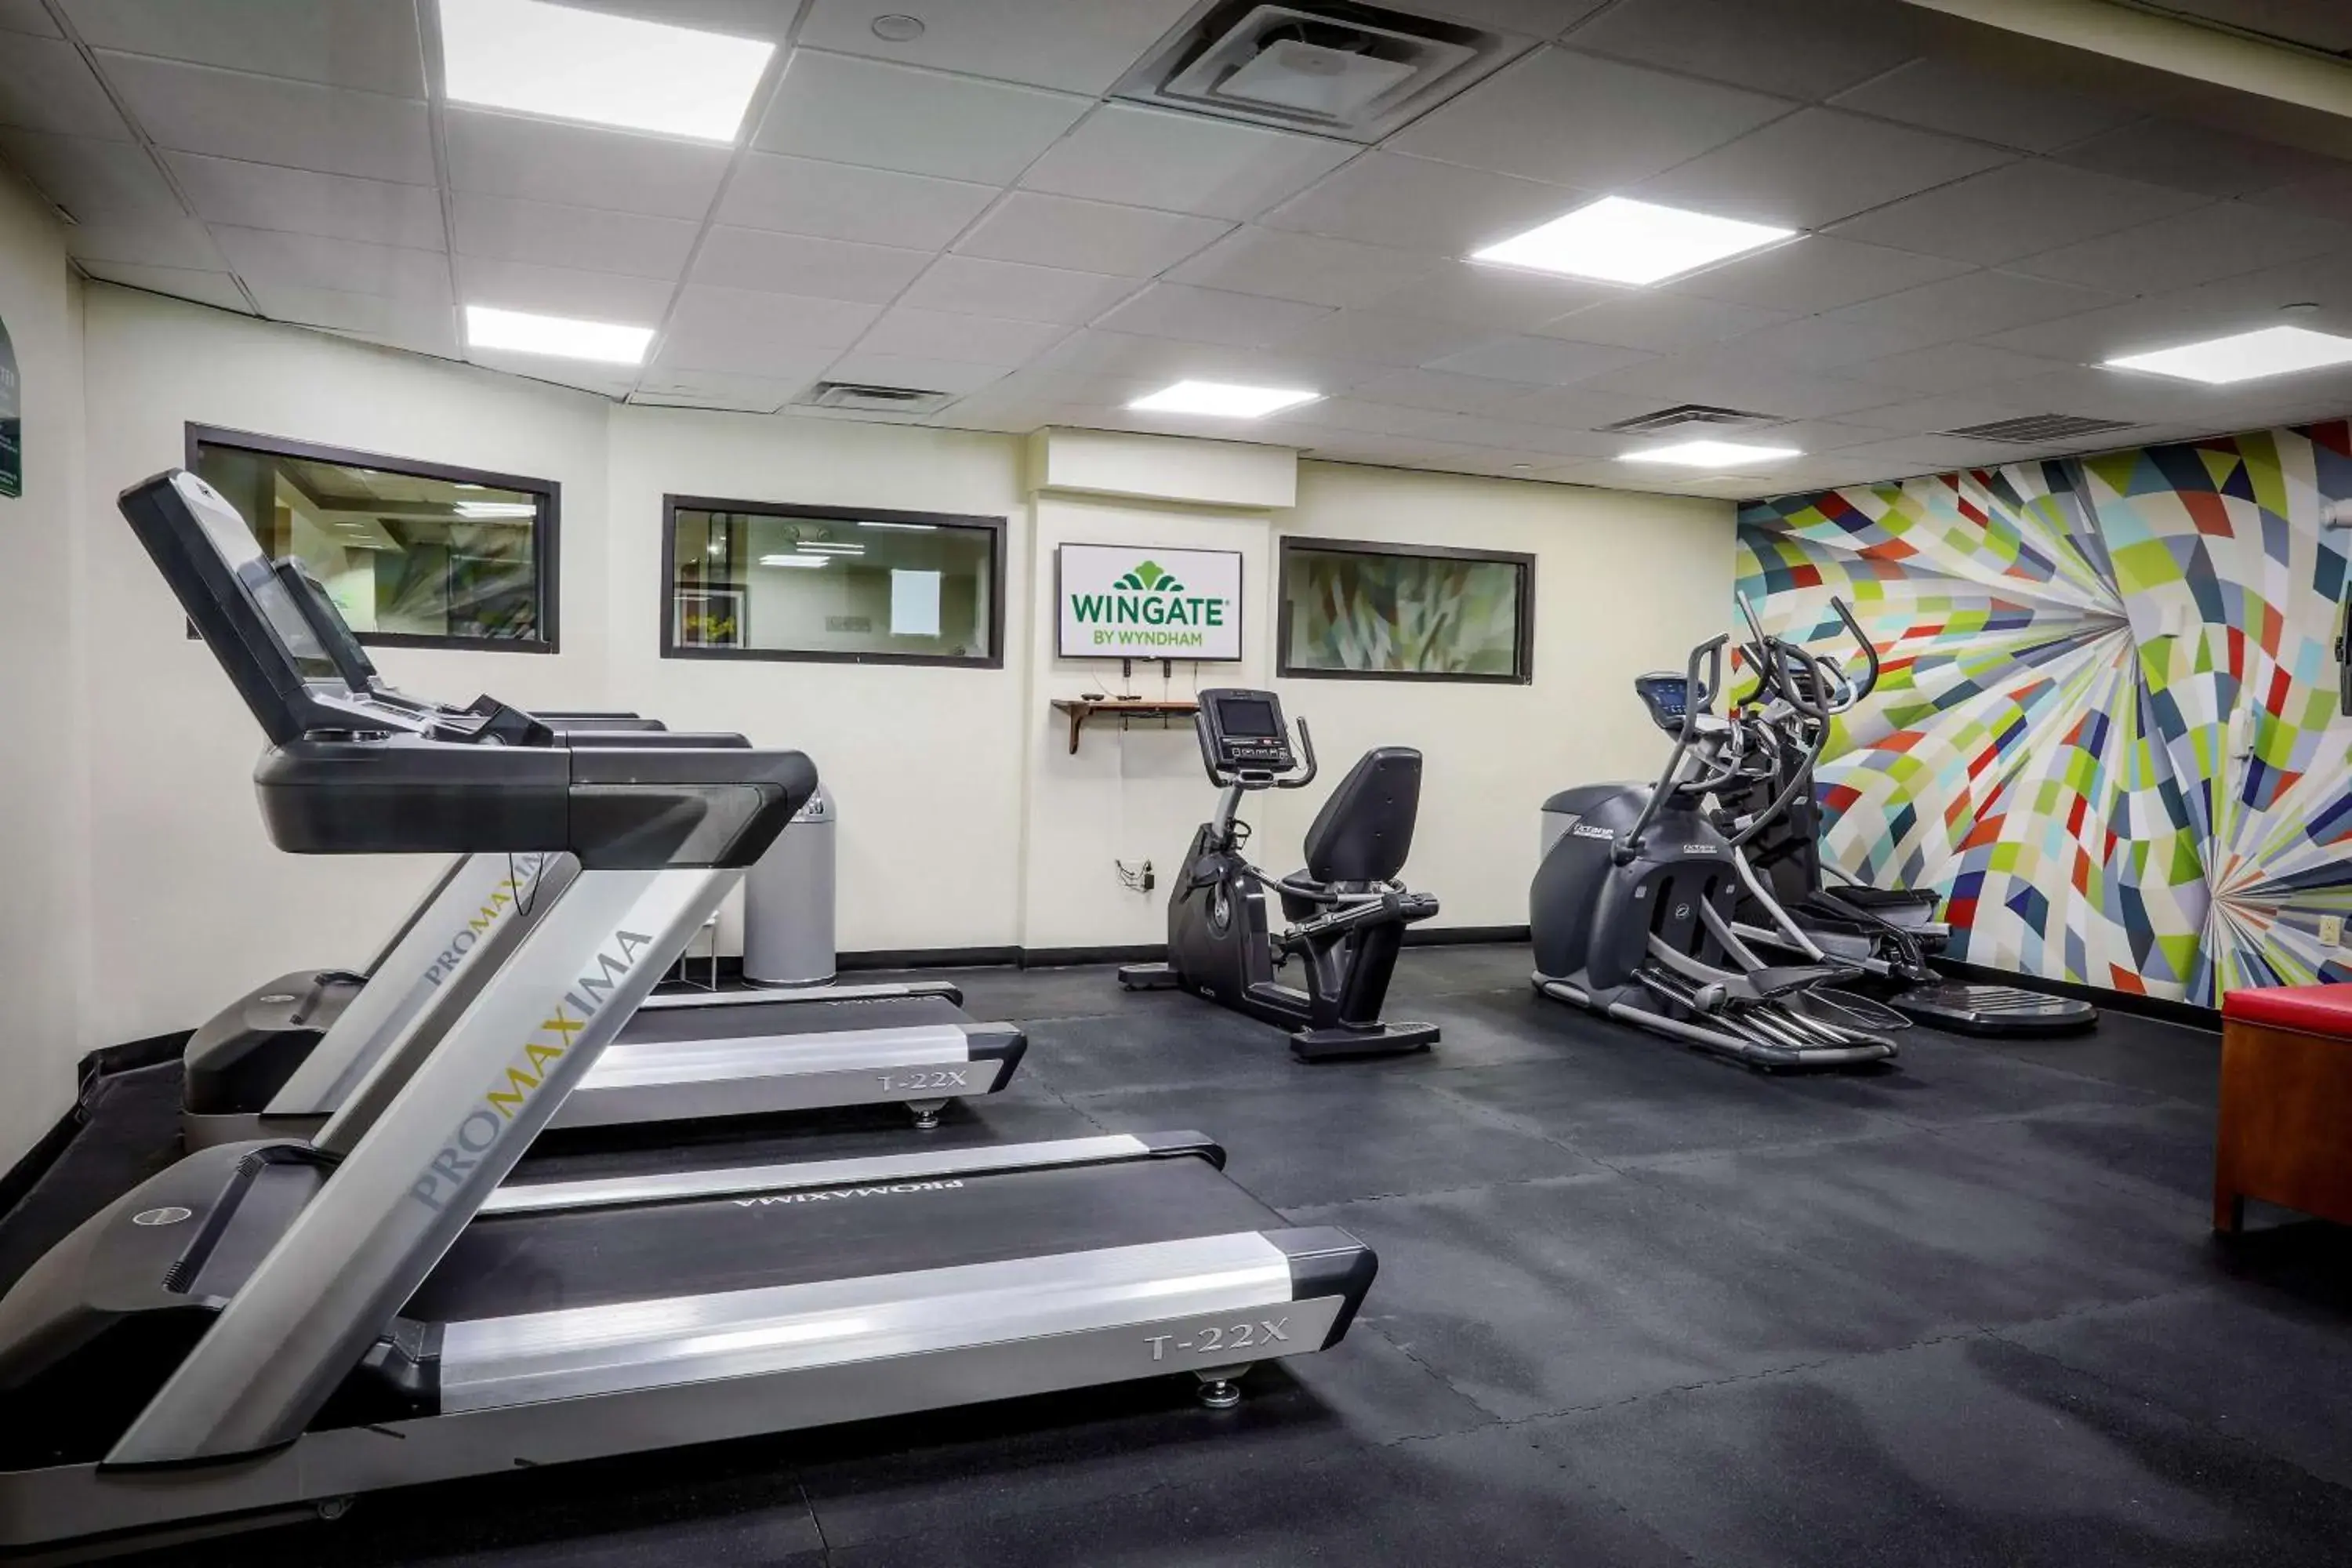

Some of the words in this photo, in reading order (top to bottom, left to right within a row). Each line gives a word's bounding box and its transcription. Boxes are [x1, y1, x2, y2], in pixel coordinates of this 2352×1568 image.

[1071, 593, 1224, 626] WINGATE
[1094, 630, 1115, 645] BY
[1119, 631, 1203, 647] WYNDHAM
[424, 853, 543, 989] PROMAXIM
[408, 930, 653, 1211] PROMAXIMA
[877, 1069, 968, 1094] T-22X
[731, 1178, 964, 1207] PROMAXIMA
[1144, 1317, 1290, 1362] T-22X
